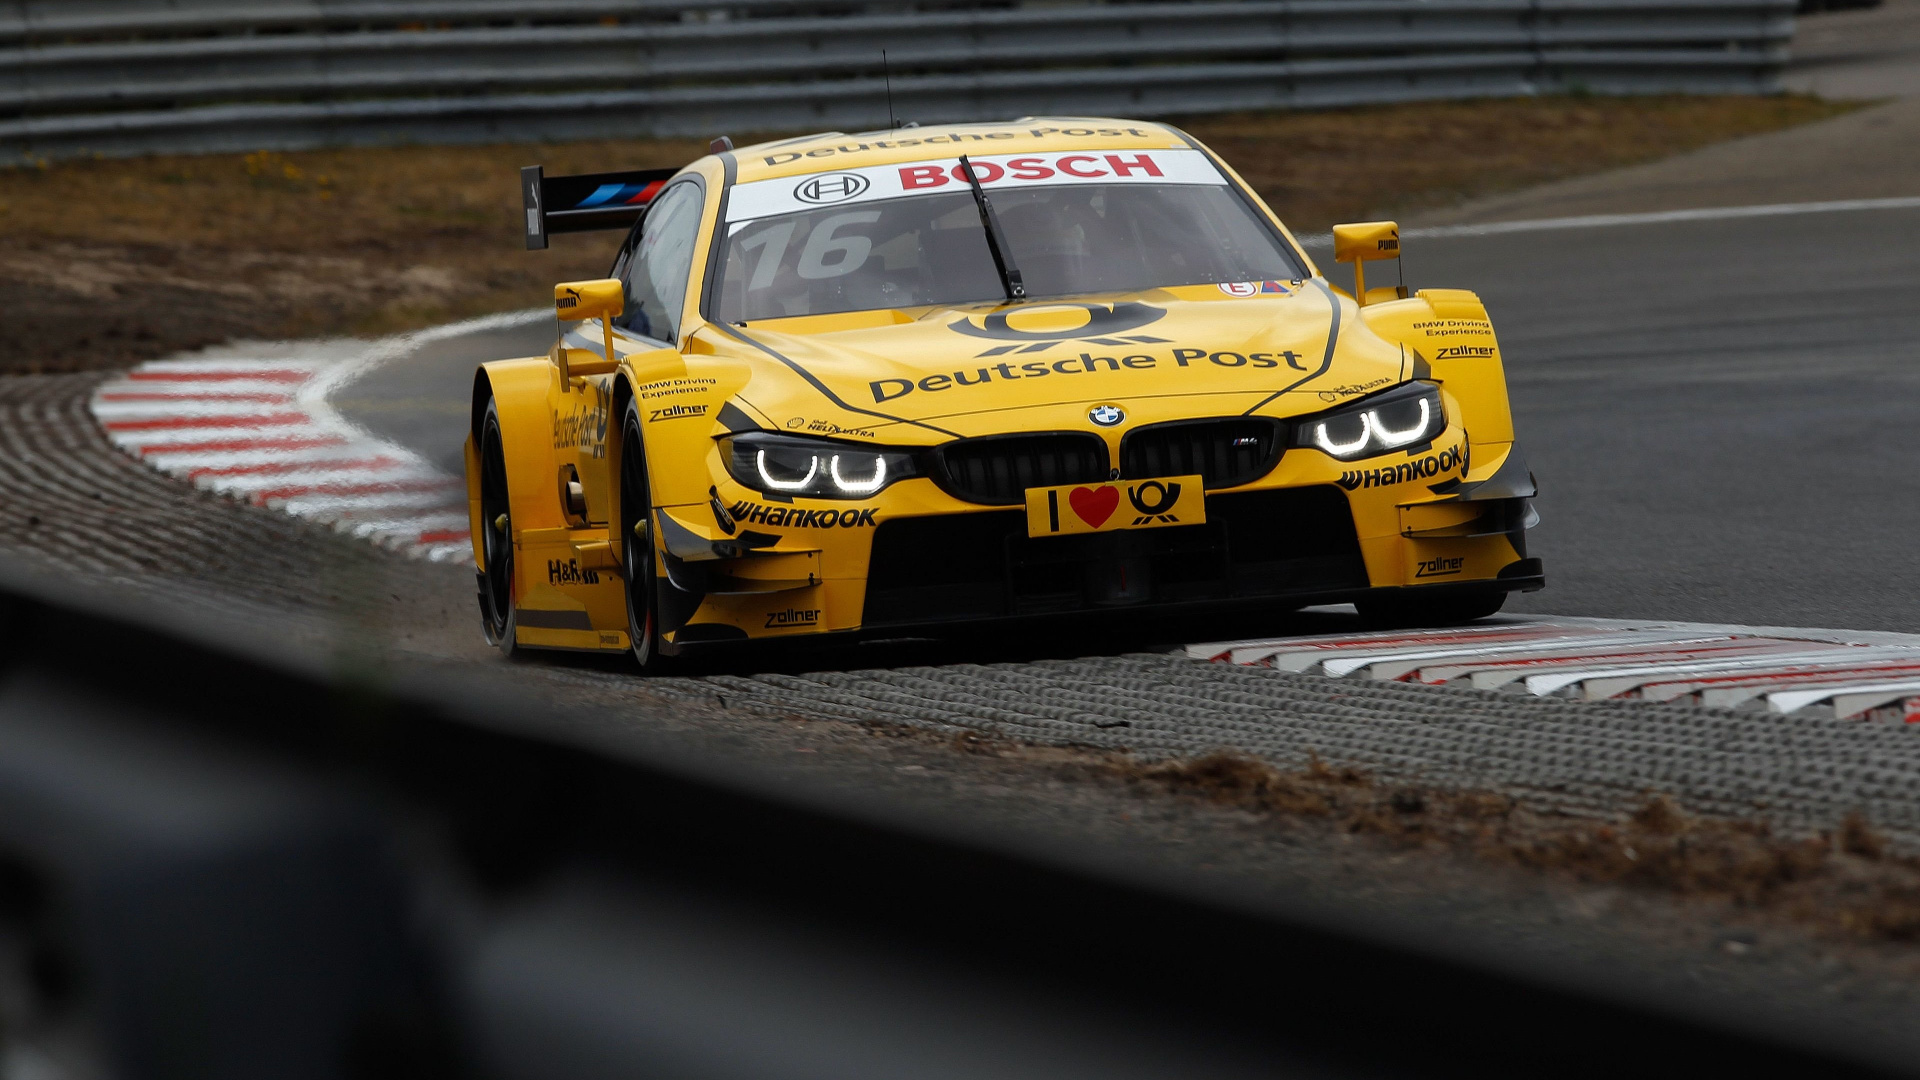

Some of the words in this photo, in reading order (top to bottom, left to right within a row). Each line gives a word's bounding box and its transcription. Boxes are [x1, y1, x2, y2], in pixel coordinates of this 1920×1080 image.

[763, 132, 1015, 167] Deutsche
[1029, 127, 1148, 138] Post
[898, 154, 1165, 191] BOSCH
[740, 210, 882, 292] 16
[1413, 321, 1444, 329] BMW
[1448, 320, 1490, 328] Driving
[1426, 328, 1491, 336] Experience
[640, 380, 671, 392] BMW
[674, 378, 716, 386] Driving
[868, 352, 1157, 404] Deutsche
[1172, 348, 1308, 371] Post
[641, 386, 708, 399] Experience
